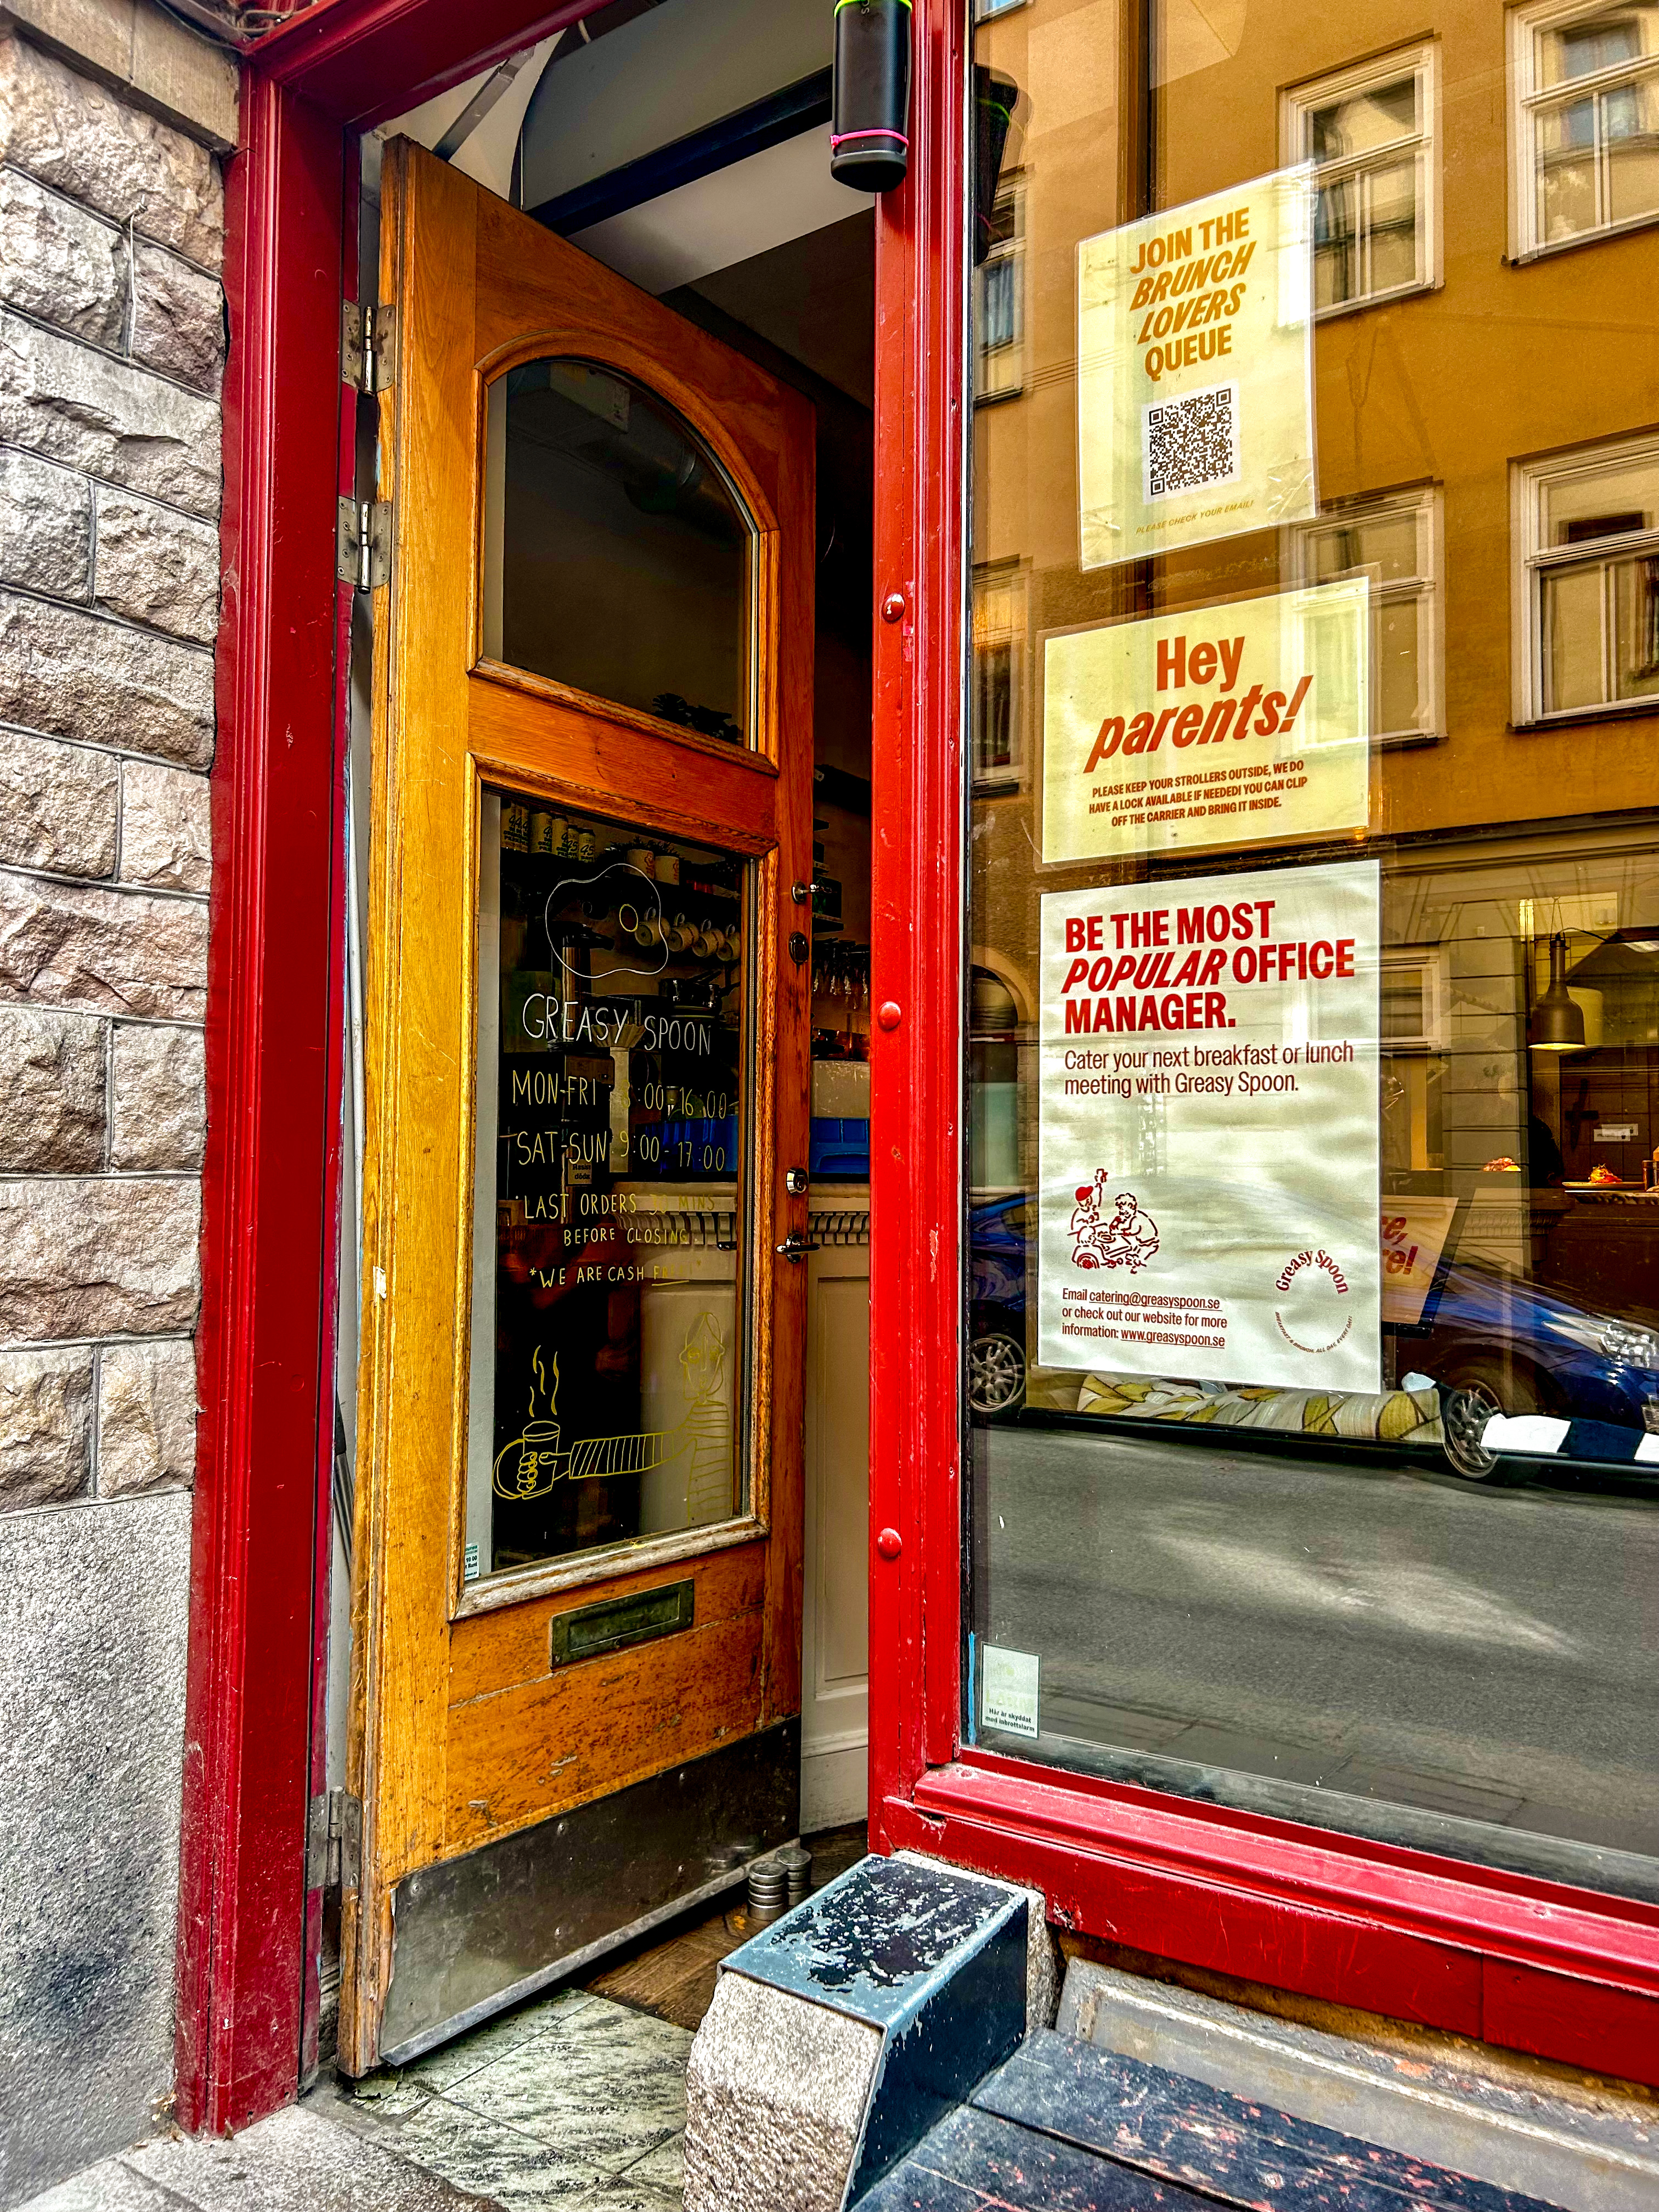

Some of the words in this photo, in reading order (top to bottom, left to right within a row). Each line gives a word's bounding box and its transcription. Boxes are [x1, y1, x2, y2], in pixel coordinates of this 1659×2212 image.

[1130, 227, 1192, 274] JOIN
[1198, 206, 1249, 250] THE
[1130, 240, 1257, 311] BRUNCH
[1137, 283, 1246, 345] LOVERS
[1145, 324, 1232, 382] QUEUE
[1136, 521, 1168, 534] PLEASE
[1169, 514, 1198, 527] CHECK
[1200, 507, 1223, 518] YOUR
[1224, 500, 1254, 513] EMAIL!
[1156, 635, 1245, 693] Hey
[1084, 674, 1314, 774] parents!
[1089, 802, 1111, 814] HAVE
[1112, 800, 1119, 811] A
[1120, 797, 1143, 810] LOCK
[1145, 791, 1192, 807] AVAILABLE
[1194, 790, 1202, 800] IF
[1243, 782, 1262, 794] YOU
[1264, 779, 1284, 792] CAN
[1285, 776, 1308, 789] CLIP
[1092, 784, 1124, 798] PLEASE
[1125, 781, 1147, 793] KEEP
[1149, 777, 1173, 790] YOUR
[1175, 770, 1227, 787] STROLLERS
[1228, 765, 1271, 780] OUTSIDE,
[1273, 762, 1288, 774] WE
[1289, 760, 1304, 771] DO
[1111, 815, 1128, 827] OFF
[1129, 812, 1146, 824] THE
[1147, 808, 1185, 822] CARRIER
[1187, 805, 1206, 817] AND
[1207, 802, 1237, 815] BRING
[1238, 800, 1247, 812] IT
[1249, 797, 1282, 810] INSIDE.
[1065, 915, 1103, 953] BE
[1110, 909, 1169, 949] THE
[1177, 900, 1276, 944] MOST
[1060, 949, 1227, 994] POPULAR
[1232, 938, 1355, 984] OFFICE
[522, 993, 629, 1044] GREASY
[644, 1015, 711, 1056] SPOON
[1065, 992, 1236, 1034] MANAGER.
[1065, 1050, 1109, 1069] Cater
[1113, 1052, 1148, 1073] your
[1153, 1046, 1190, 1068] next
[1194, 1043, 1278, 1066] breakfast
[1283, 1047, 1301, 1064] or
[1306, 1040, 1353, 1063] lunch
[1065, 1074, 1132, 1098] meeting
[1136, 1072, 1170, 1093] with
[1175, 1073, 1233, 1096] Greasy
[1238, 1071, 1299, 1096] Spoon.
[524, 1193, 569, 1219] LAST
[580, 1193, 636, 1215] ORDERS
[650, 1194, 668, 1215] 30
[679, 1193, 715, 1212] MINS
[564, 1228, 615, 1246] BEFORE
[627, 1228, 689, 1245] CLOSING
[577, 1266, 602, 1284] ARE
[608, 1266, 644, 1282] CASH
[1276, 1250, 1313, 1291] Greasy
[1315, 1249, 1348, 1294] Spoon
[1062, 1307, 1072, 1317] or
[1074, 1307, 1104, 1319] check
[1107, 1309, 1122, 1321] out
[1125, 1311, 1141, 1322] our
[1143, 1311, 1182, 1325] website
[1184, 1313, 1199, 1326] for
[1201, 1316, 1227, 1328] more
[1063, 1288, 1087, 1301] Email
[1089, 1290, 1220, 1310] catering@greasyspoon.se
[1062, 1323, 1118, 1339] information:
[1121, 1329, 1225, 1347] www.greasyspoon.se
[999, 1718, 1035, 1733] inbrottslarm
[1008, 1712, 1031, 1723] skyddat
